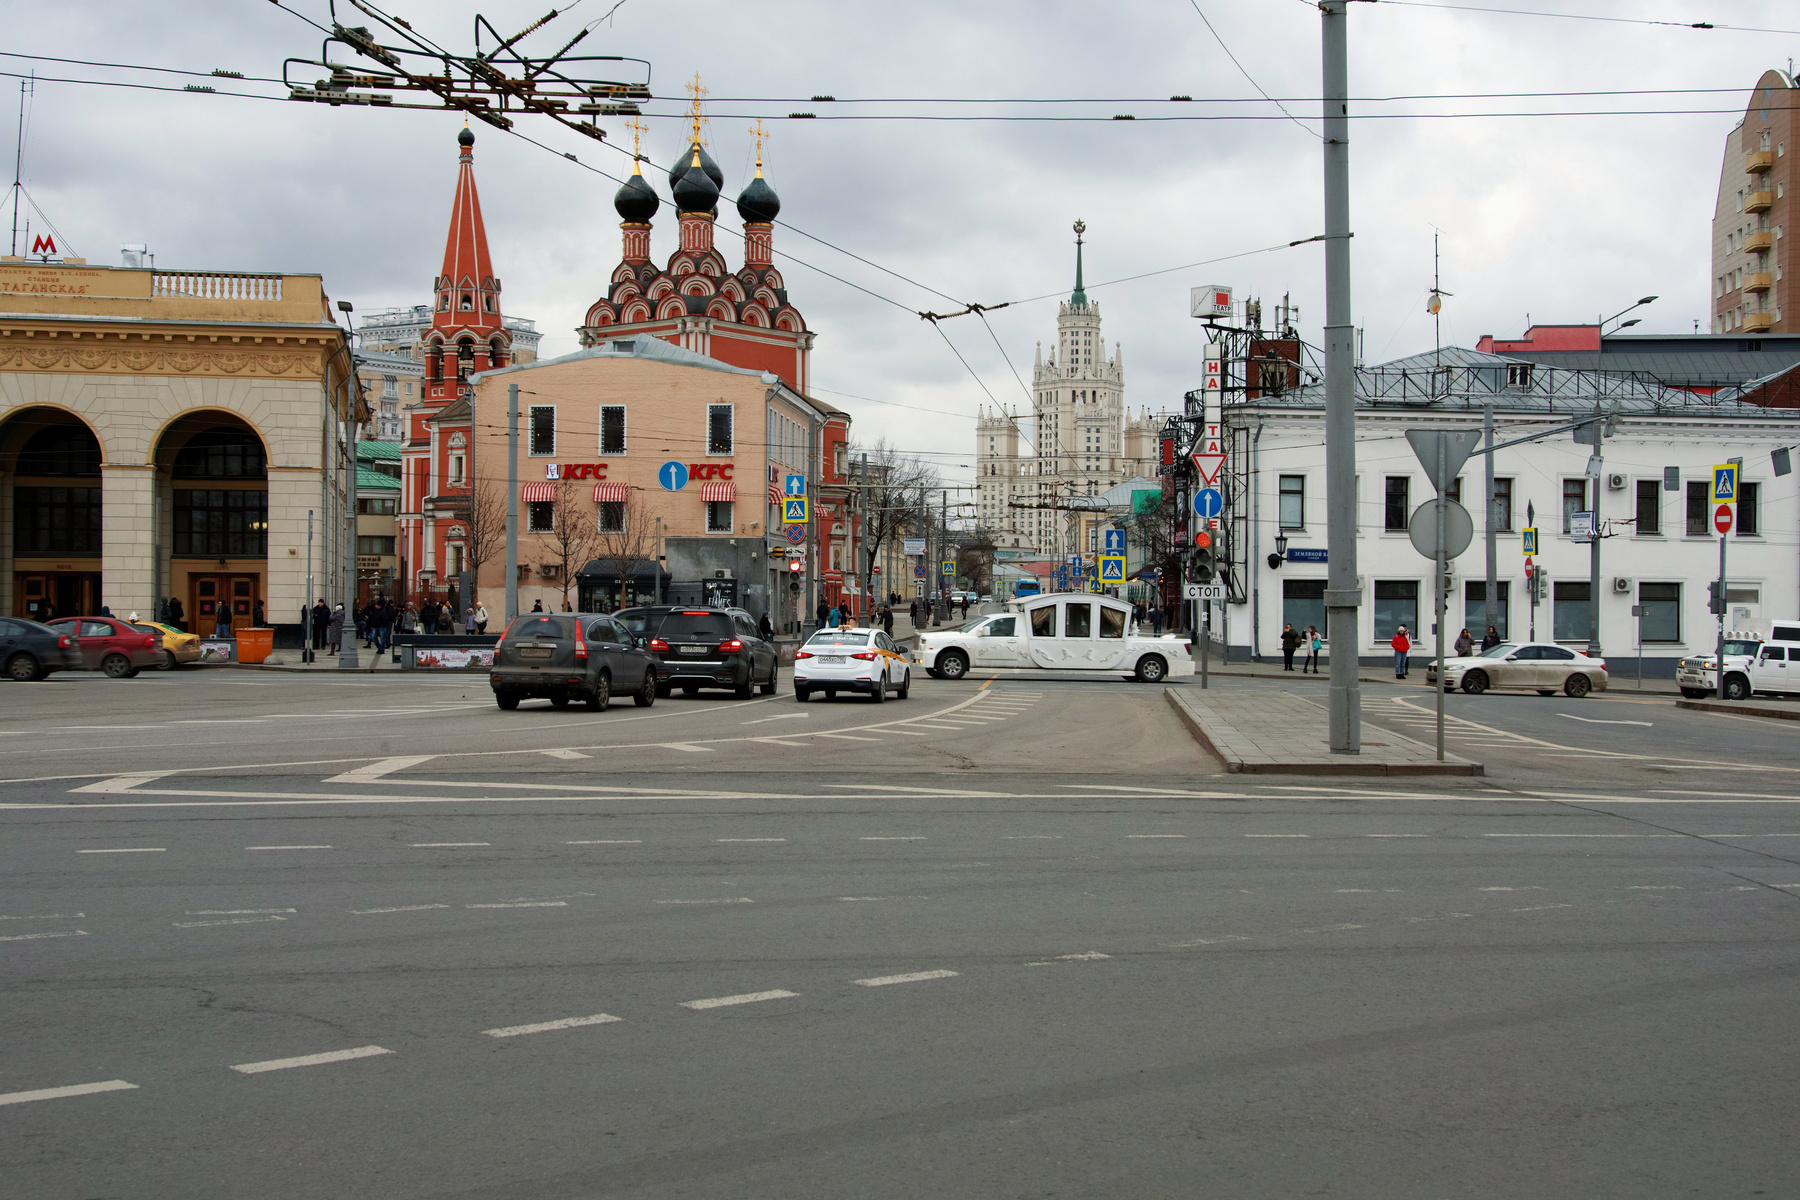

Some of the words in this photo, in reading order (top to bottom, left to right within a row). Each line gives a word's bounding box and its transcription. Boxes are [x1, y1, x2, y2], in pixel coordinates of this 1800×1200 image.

[562, 463, 608, 479] KFC
[689, 463, 734, 479] KFC
[1188, 586, 1220, 597] СТОП
